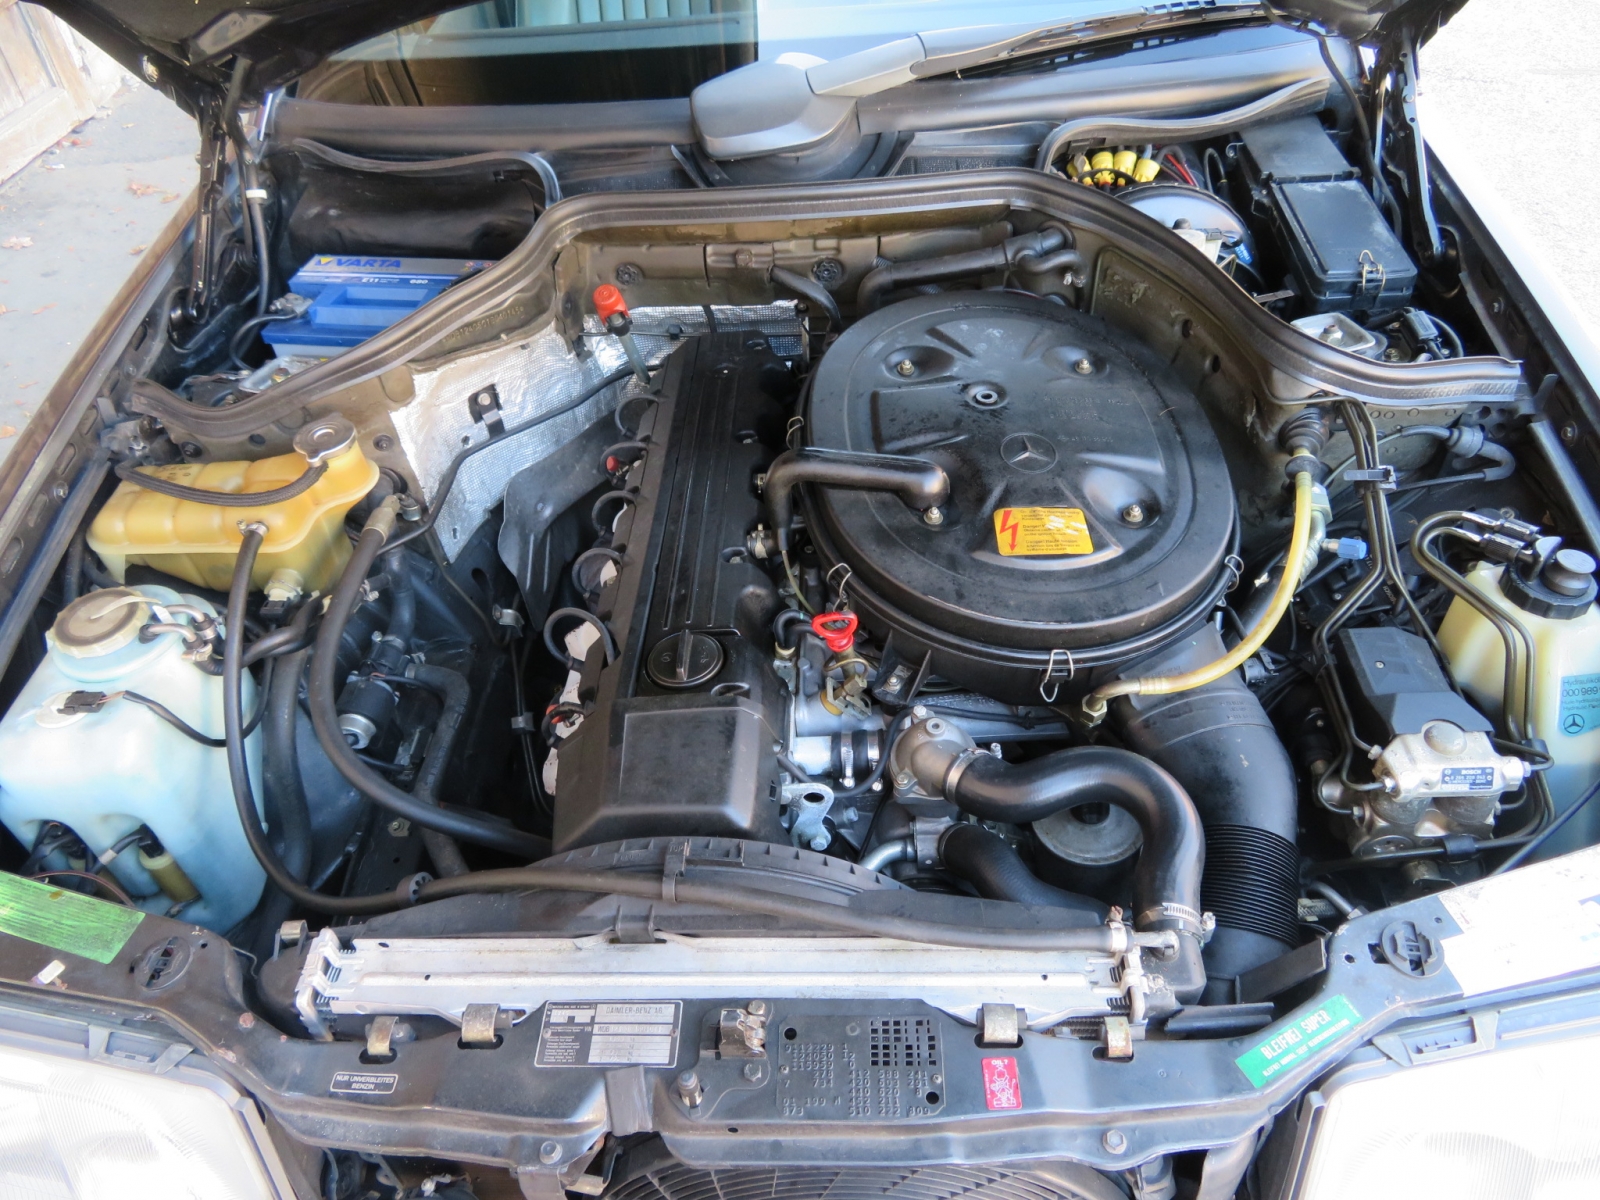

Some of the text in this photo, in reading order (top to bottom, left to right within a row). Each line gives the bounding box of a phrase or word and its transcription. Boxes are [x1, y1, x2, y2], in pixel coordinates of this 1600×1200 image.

[336, 257, 401, 267] VARTA
[1562, 686, 1598, 697] 000 989
[1260, 1009, 1332, 1060] BLEIFREI SUPER
[805, 1097, 826, 1107] 199
